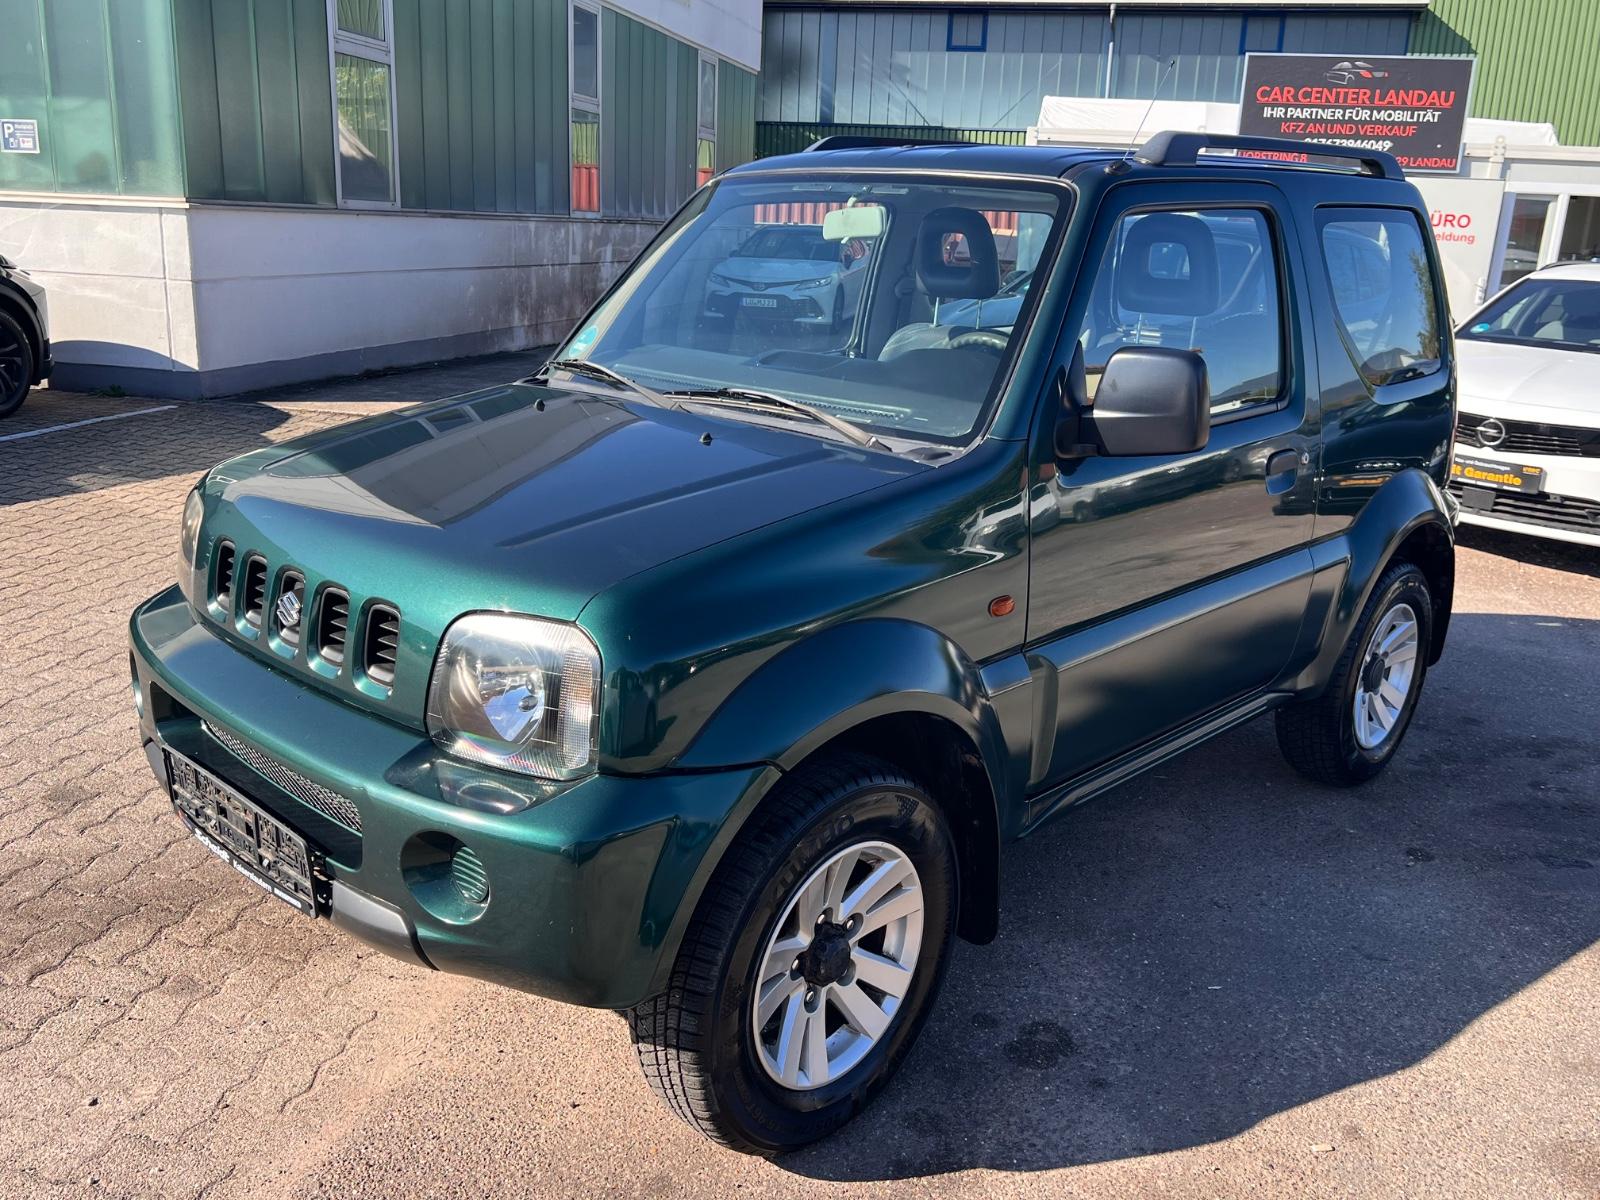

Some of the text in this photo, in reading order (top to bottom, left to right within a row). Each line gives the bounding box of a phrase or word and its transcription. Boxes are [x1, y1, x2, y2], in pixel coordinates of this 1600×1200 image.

[1256, 85, 1455, 108] CAR CENTER LANDAU
[1263, 106, 1442, 123] IHR PARTNER FÜR MOBILITÄT
[1280, 122, 1417, 137] KFZ AN UND VERKAUF
[1409, 157, 1456, 168] LANDAU
[1430, 210, 1472, 228] ÜRO
[1435, 232, 1476, 245] eldung
[1464, 466, 1522, 486] Garantie
